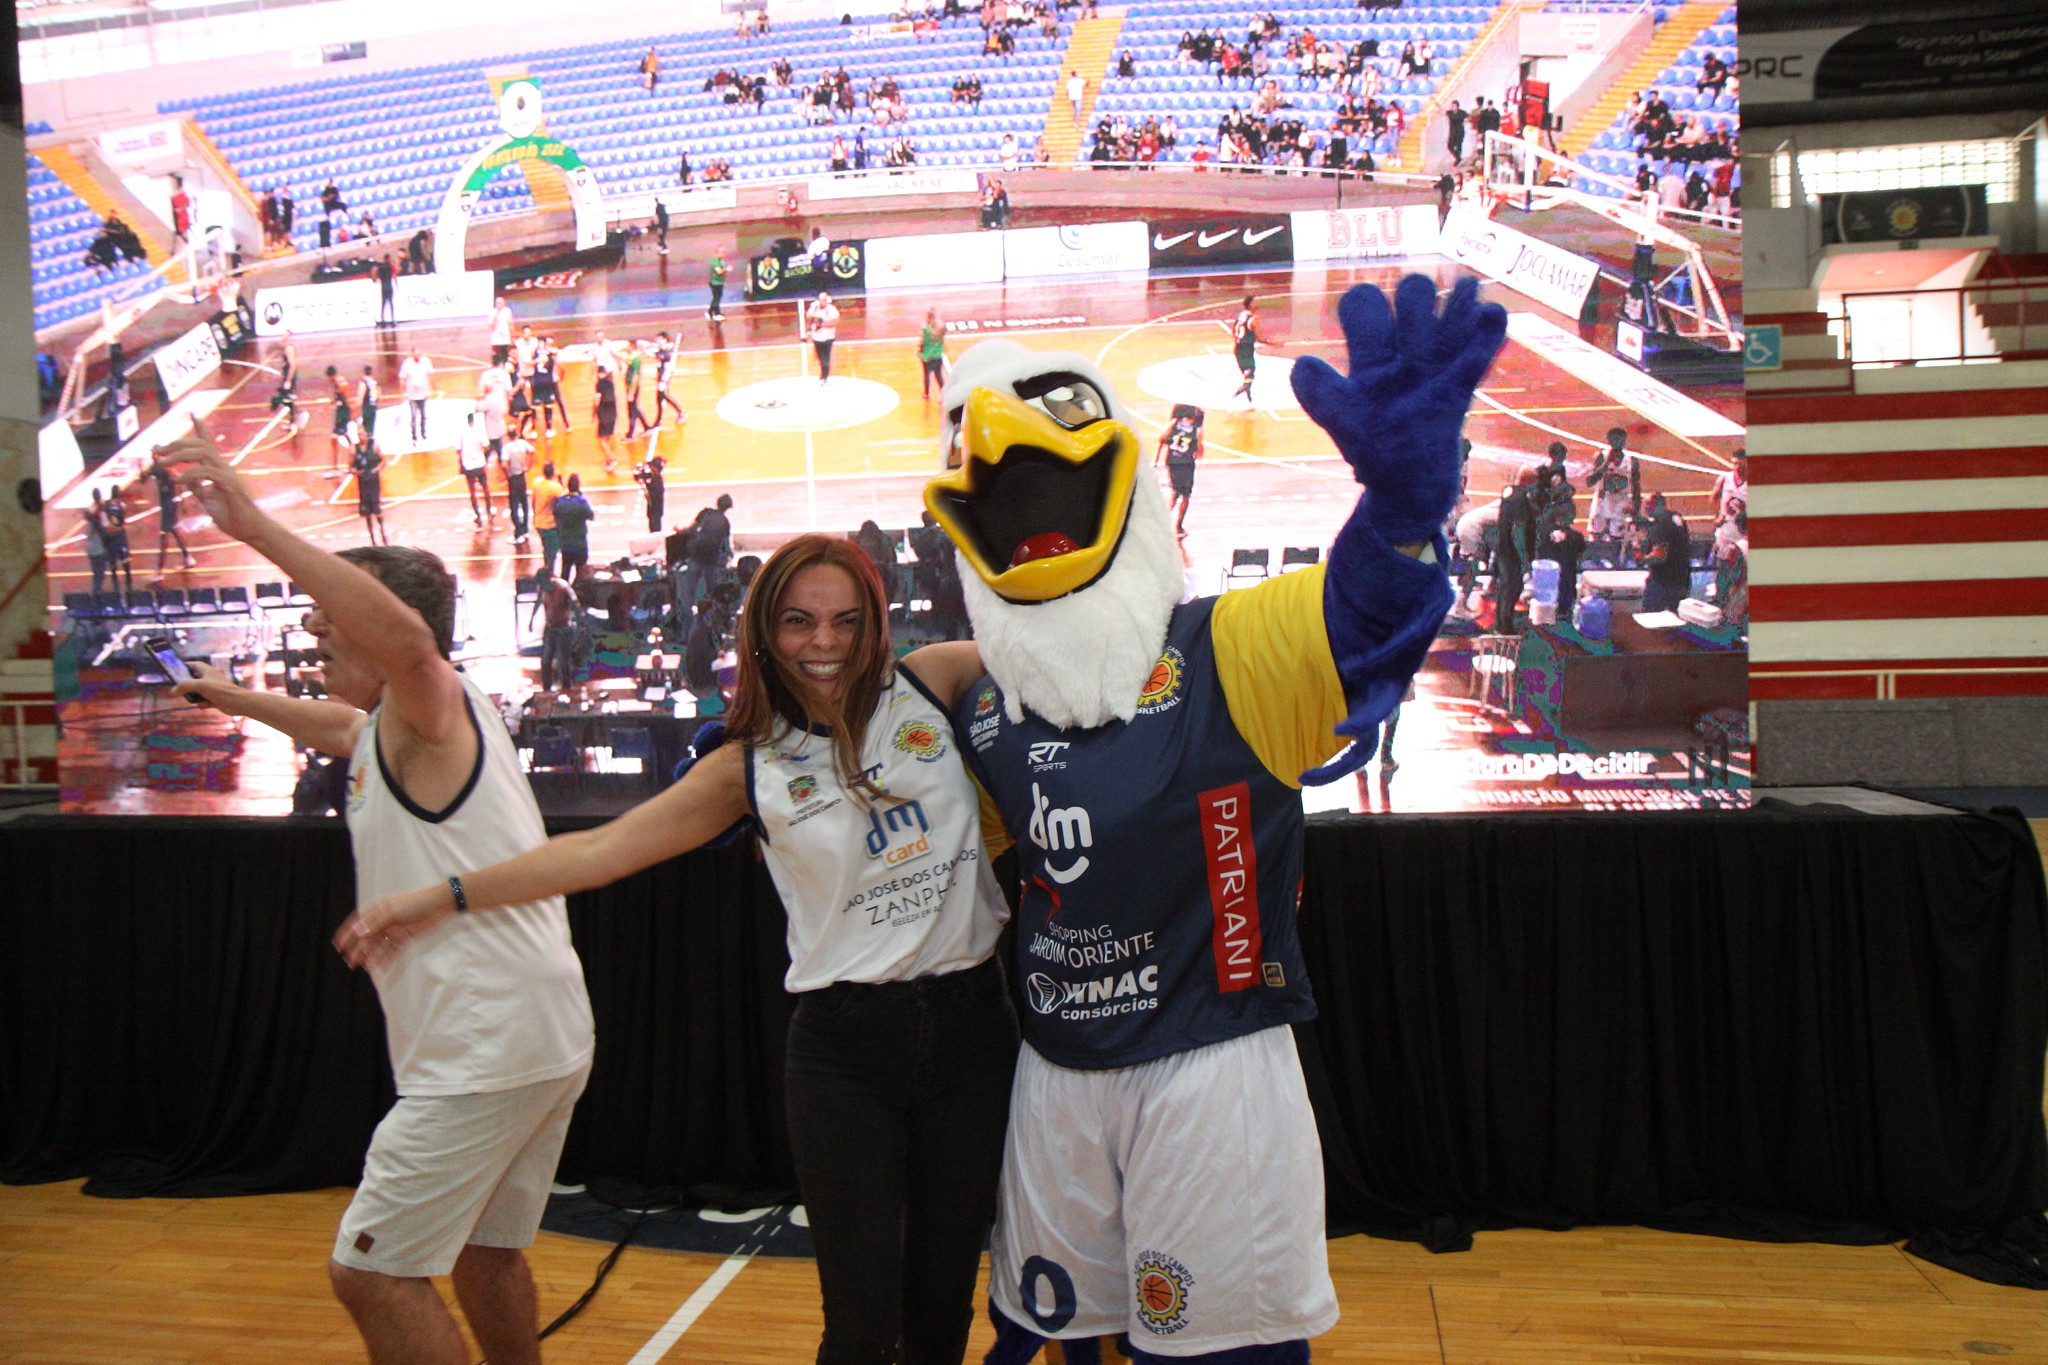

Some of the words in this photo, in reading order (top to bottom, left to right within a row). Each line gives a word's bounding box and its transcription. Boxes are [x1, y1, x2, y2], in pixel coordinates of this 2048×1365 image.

[1328, 205, 1404, 250] BLU
[1136, 696, 1181, 714] SKETBALL
[886, 834, 930, 864] card
[868, 879, 900, 901] JOSÉ
[902, 869, 931, 889] DOS
[1212, 797, 1253, 979] PATRIANI
[1049, 922, 1113, 944] SHOPPING
[1030, 933, 1067, 966] JARDIM
[1068, 931, 1155, 969] ORIENTE
[1061, 998, 1158, 1021] consórcios
